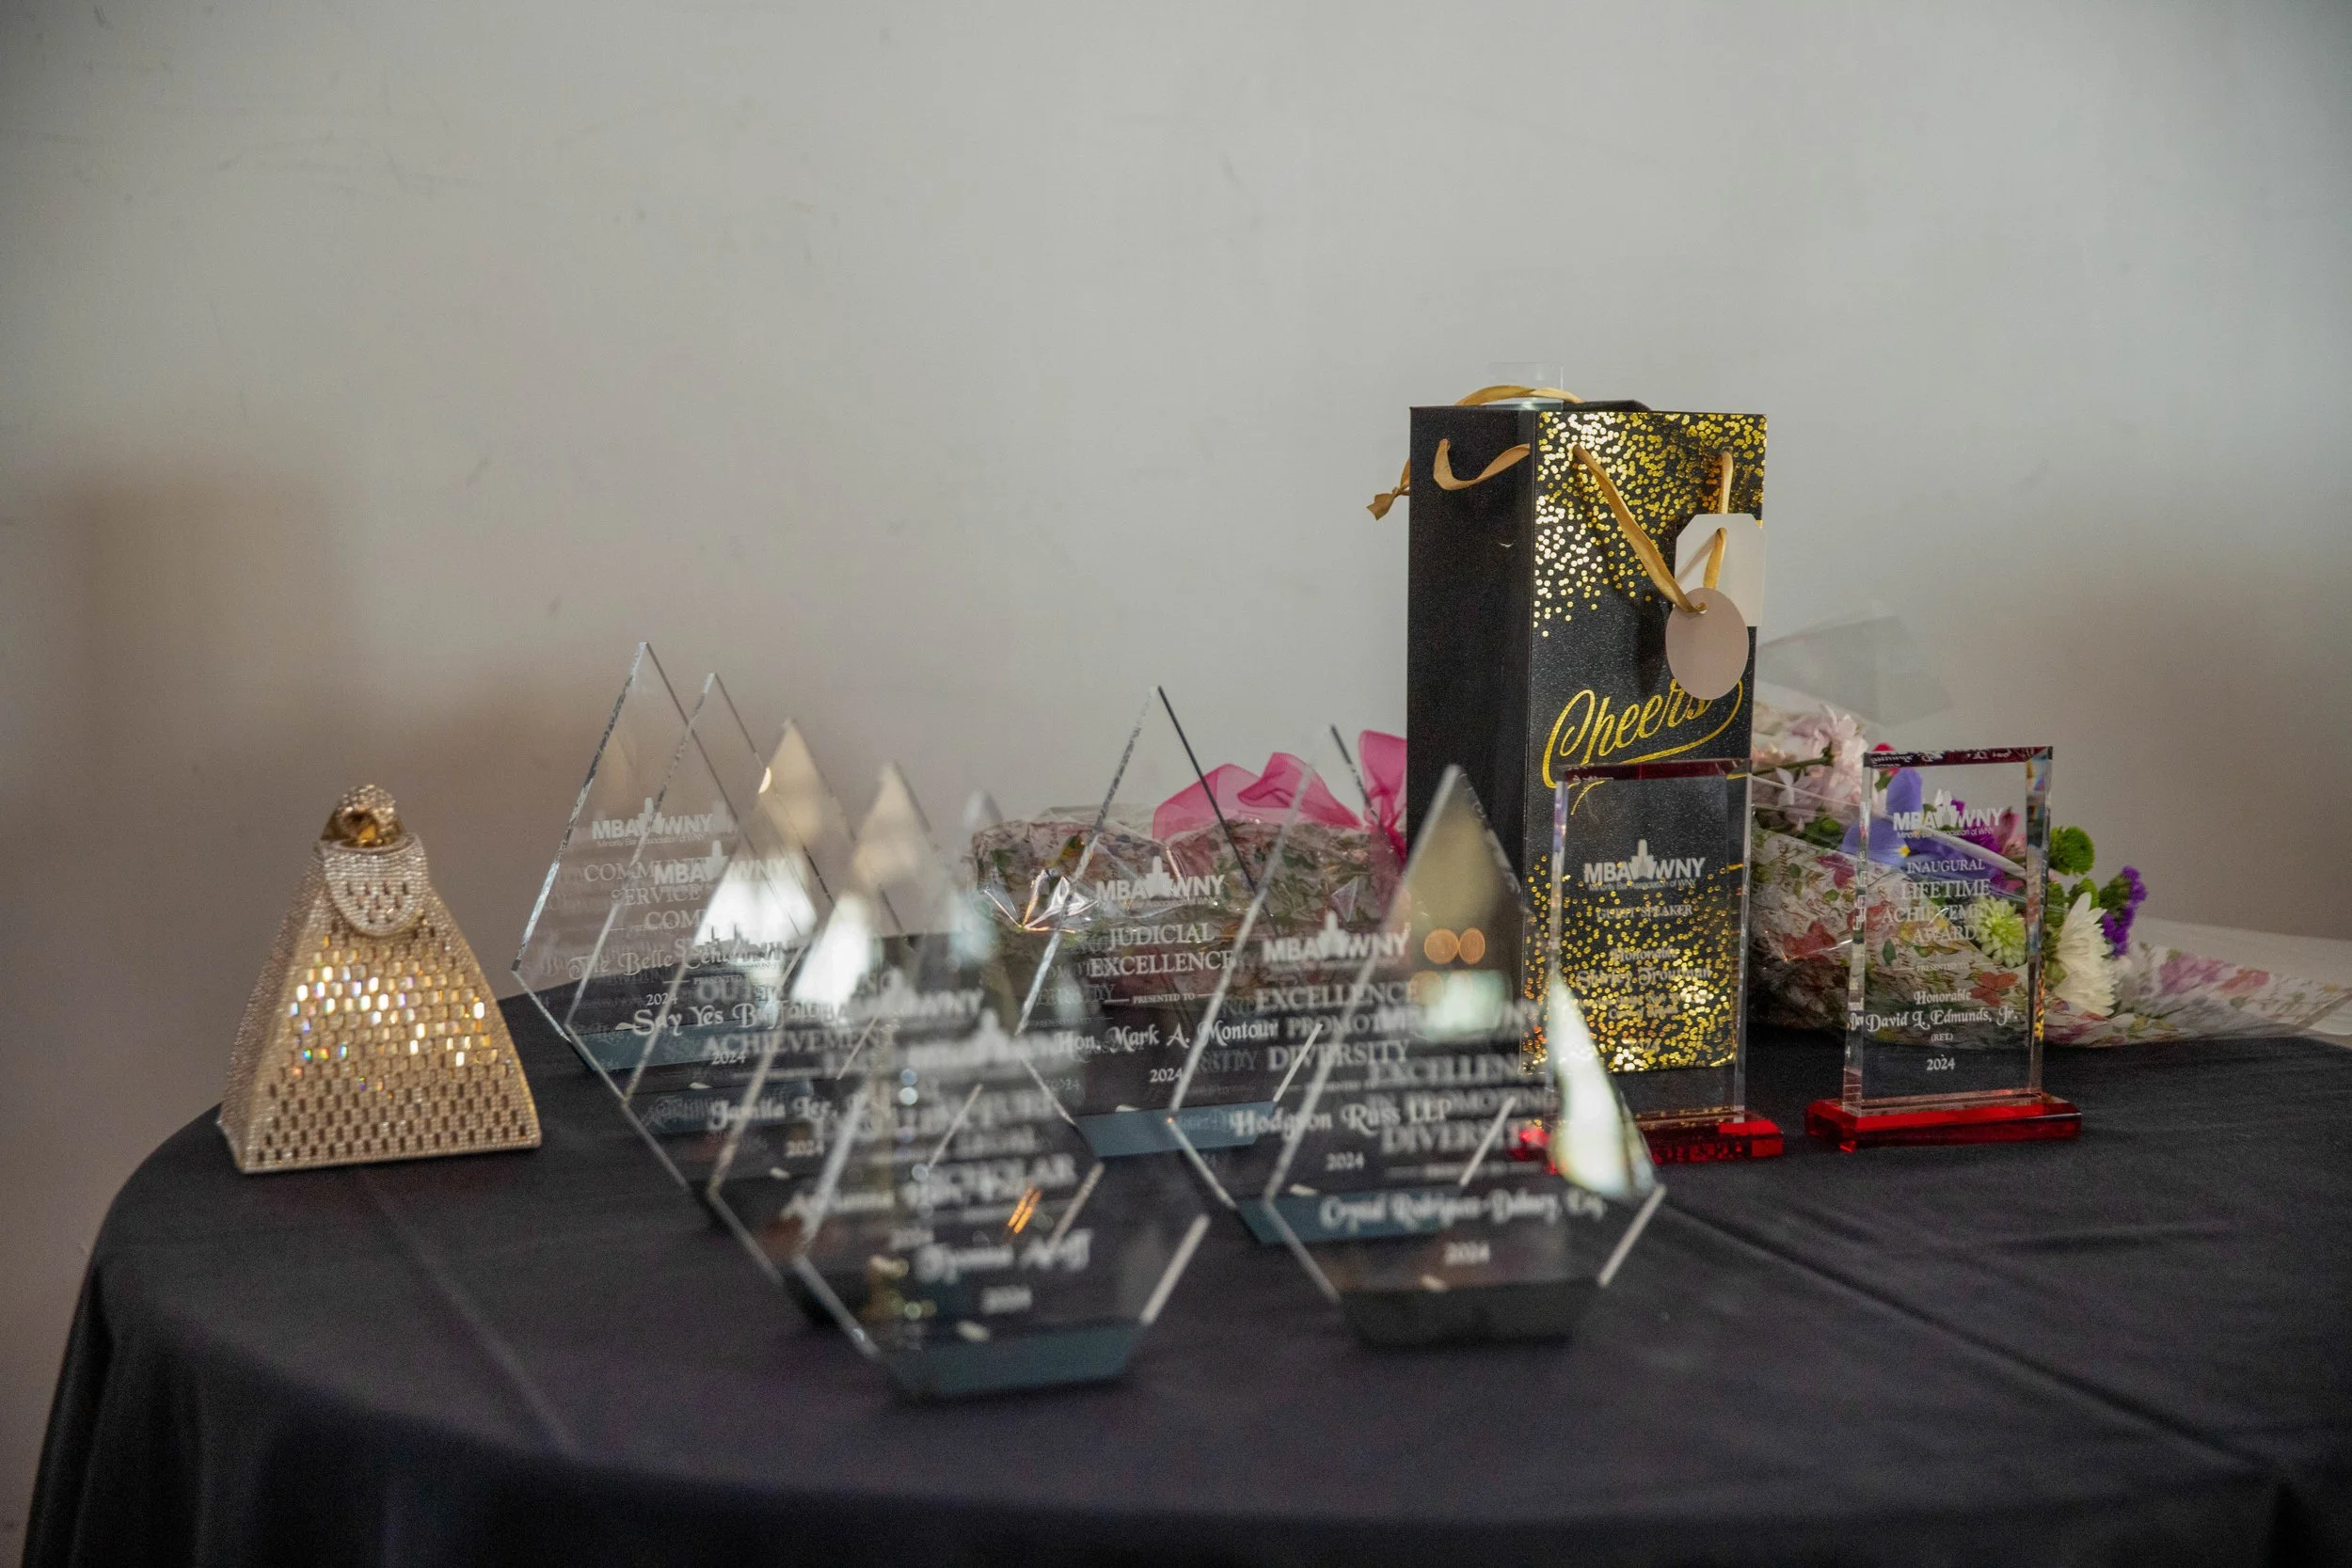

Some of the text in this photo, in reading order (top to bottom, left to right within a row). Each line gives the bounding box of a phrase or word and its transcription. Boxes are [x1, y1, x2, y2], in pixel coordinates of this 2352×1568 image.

[591, 813, 712, 840] MBA WNY
[1893, 807, 2004, 831] MBA WNY
[654, 860, 706, 885] MBA
[1584, 857, 1705, 882] MBA WNY
[1907, 858, 1986, 874] INAUGURAL
[1095, 874, 1225, 901] MBA WNY
[1900, 878, 1991, 901] LIFETIME
[1641, 904, 1692, 919] SPEAKER
[1108, 922, 1216, 951] JUDICIAL
[1262, 927, 1410, 962] MBA WNY
[1914, 925, 1977, 942] AWARD
[617, 946, 674, 977] Belle
[1090, 950, 1240, 977] EXCELLENCE
[646, 992, 678, 1006] 2024
[1133, 991, 1196, 1004] PRESENTED TO
[1914, 988, 1972, 1006] Honorable
[631, 1007, 683, 1037] Say
[688, 1004, 724, 1027] Yes
[1866, 1010, 1910, 1033] David
[1930, 1006, 1993, 1026] Edmunds,
[1996, 1006, 2018, 1027] Jr.
[1107, 1023, 1160, 1053] Mark
[1166, 1023, 1190, 1049] A.
[1197, 1020, 1279, 1046] Montour
[711, 1050, 747, 1065] 2024
[1925, 1056, 1957, 1070] 2024
[1150, 1068, 1185, 1083] 2024
[1325, 1153, 1364, 1171] 2024
